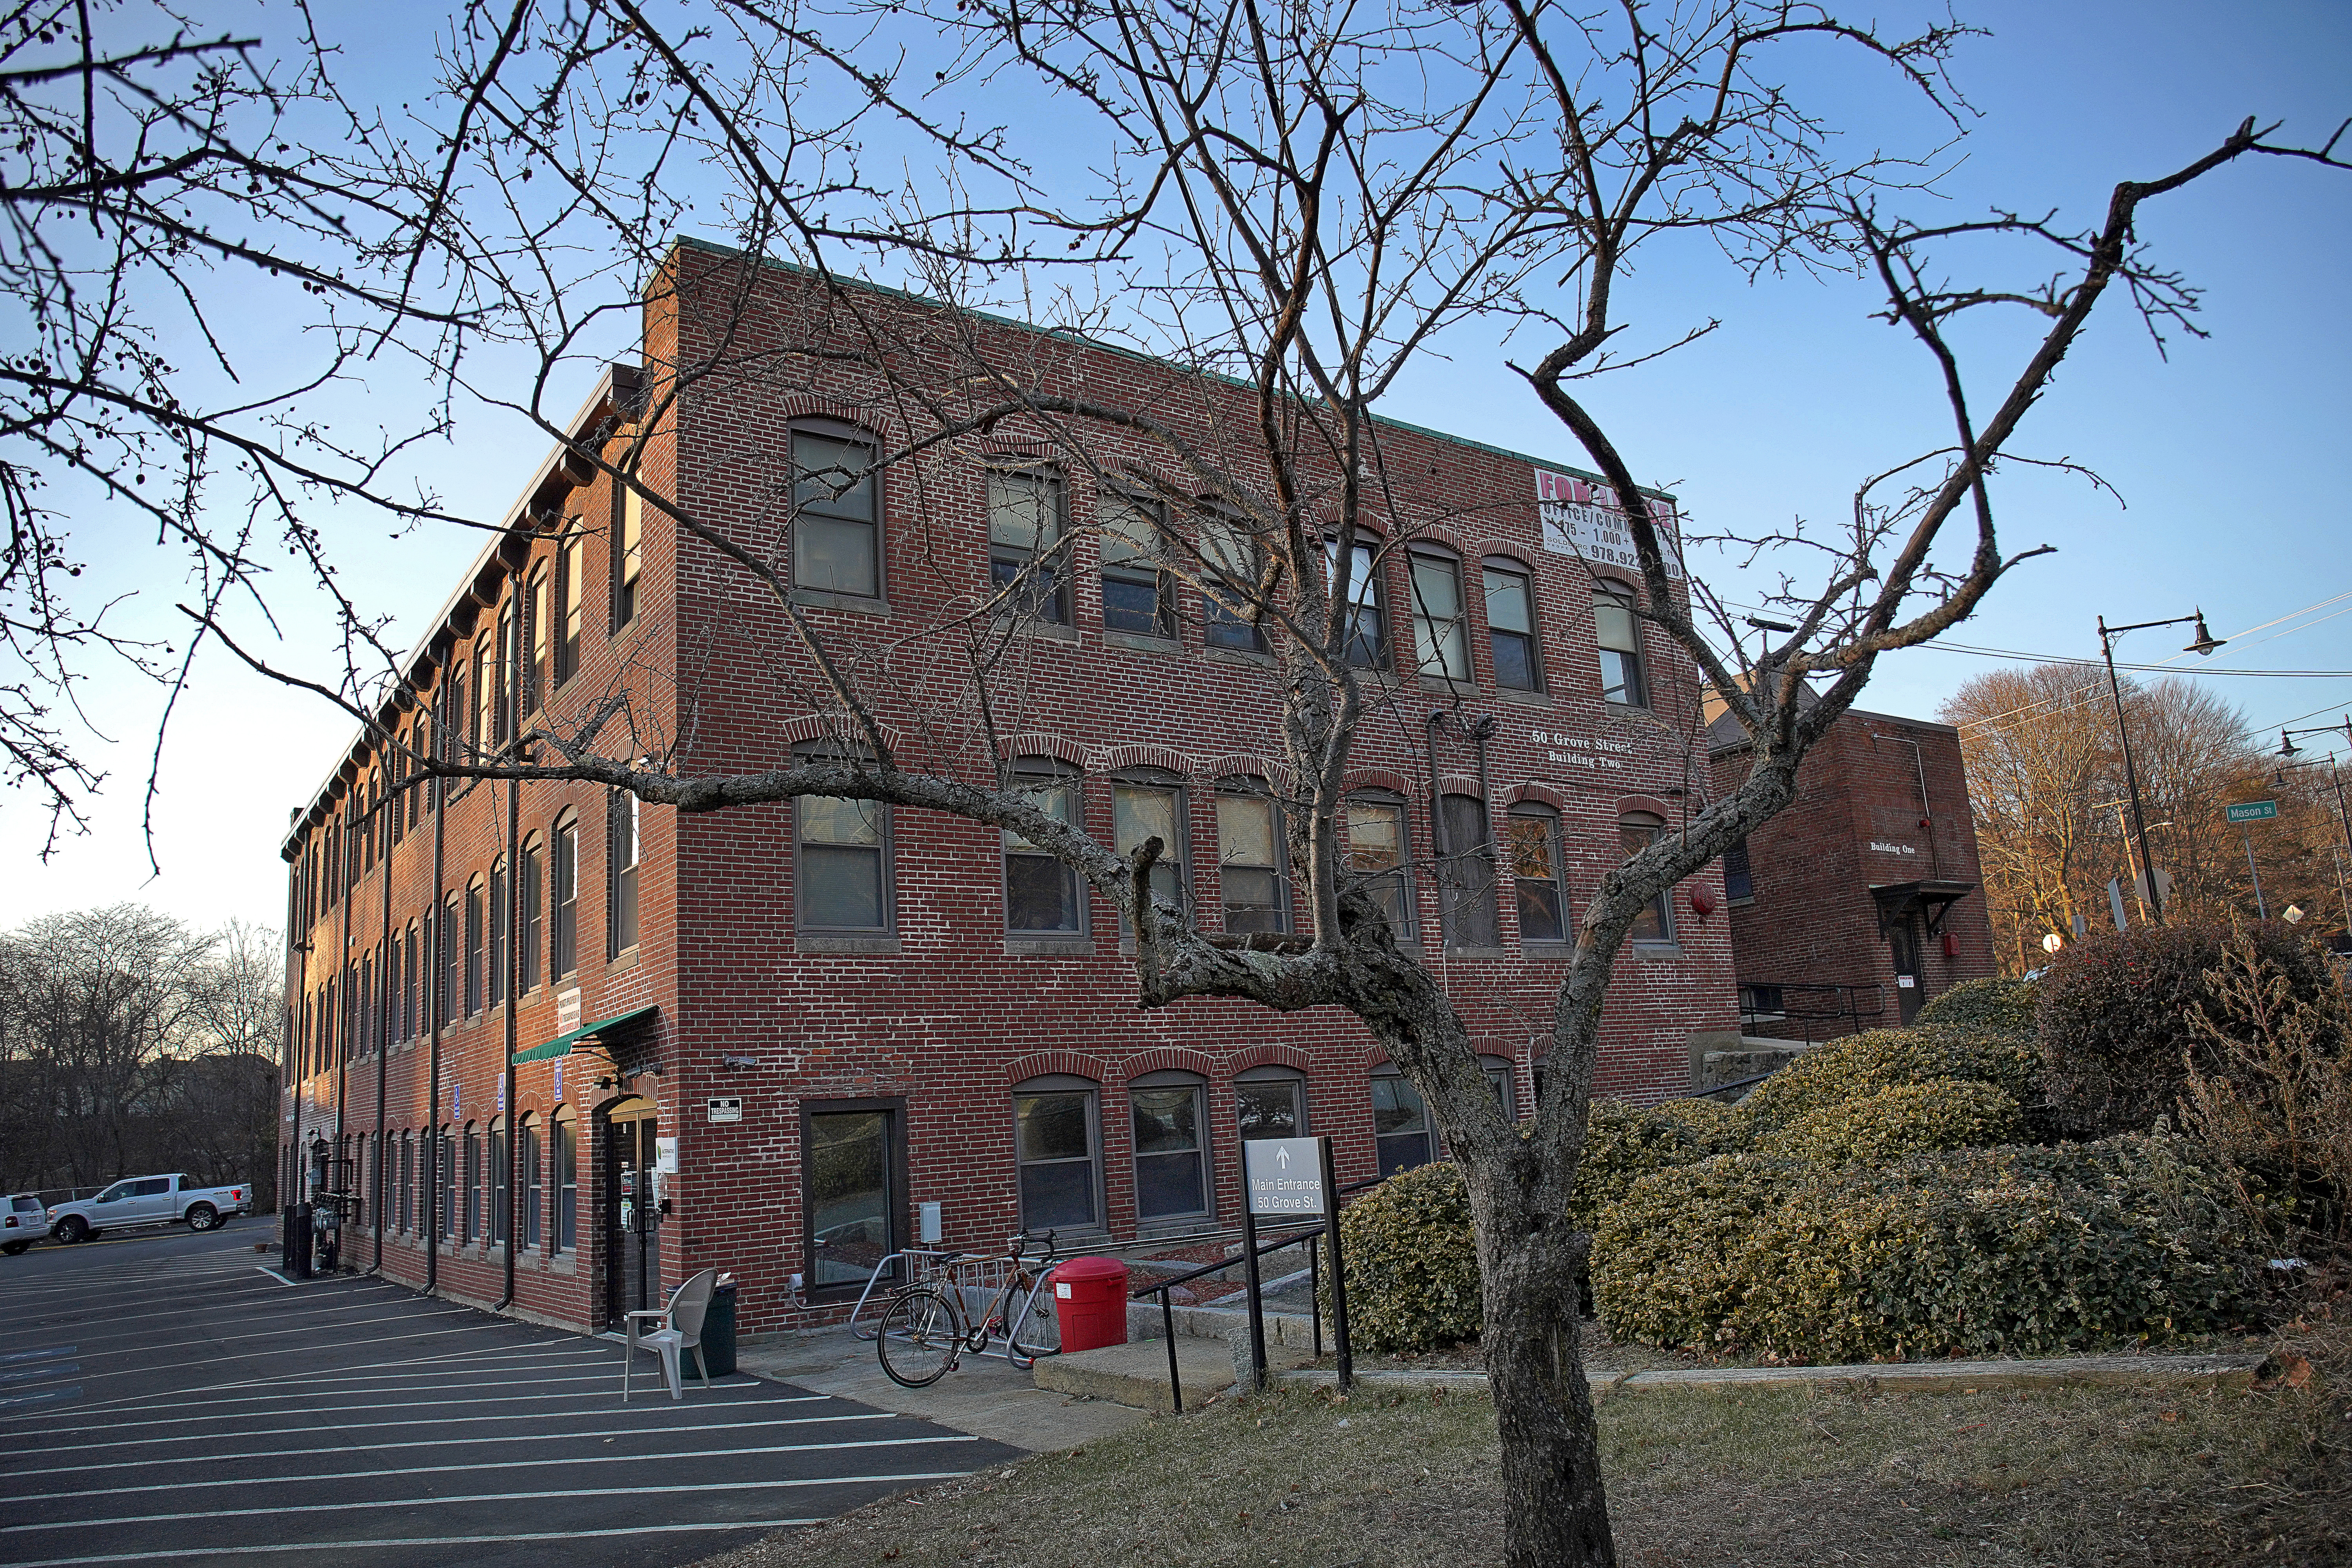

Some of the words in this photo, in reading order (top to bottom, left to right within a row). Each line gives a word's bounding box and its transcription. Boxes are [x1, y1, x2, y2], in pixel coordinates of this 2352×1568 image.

[1539, 472, 1592, 509] FOR
[1599, 487, 1671, 529] LESE
[1593, 528, 1621, 546] 1,000
[1547, 543, 1588, 554] PROPERES
[1591, 545, 1679, 577] 978.92200
[1532, 730, 1547, 744] 50
[1553, 733, 1590, 748] Grove
[1595, 739, 1632, 754] Street
[1548, 751, 1595, 769] Building
[1599, 757, 1621, 769] Two
[2231, 808, 2261, 818] Mason
[1870, 842, 1900, 855] Building
[1902, 845, 1915, 854] One
[567, 994, 579, 1005] PROPERTY
[563, 1009, 579, 1023] TRESPASSING
[1252, 1178, 1274, 1191] Main
[1277, 1178, 1320, 1191] Entrance
[1258, 1196, 1269, 1208] 50
[1272, 1196, 1301, 1208] Grove
[1303, 1195, 1317, 1208] St.
